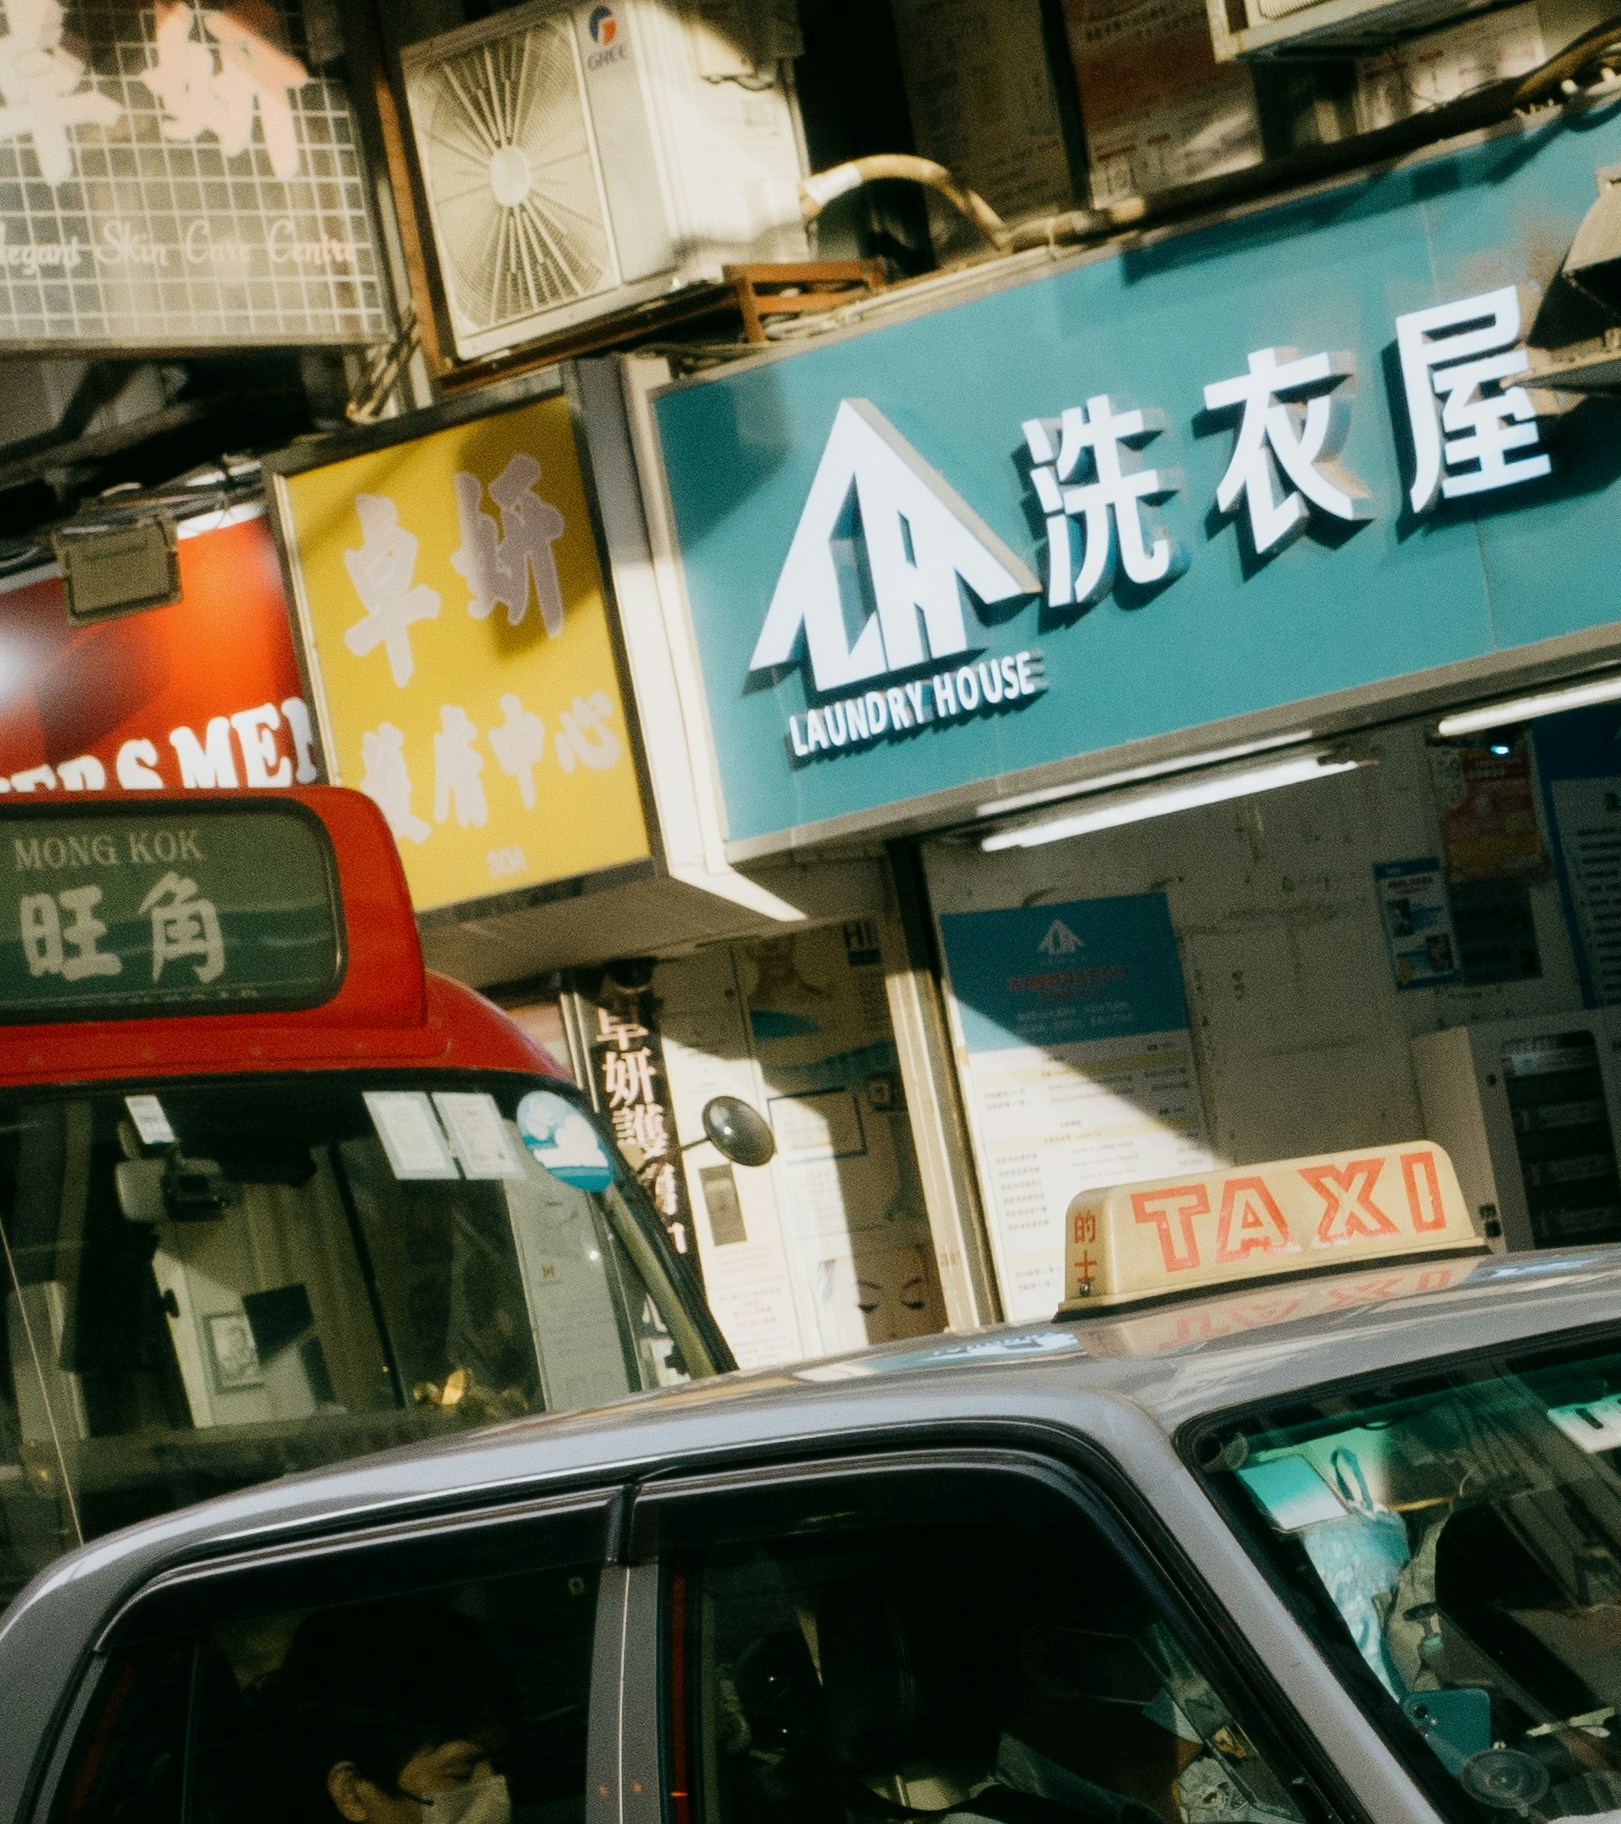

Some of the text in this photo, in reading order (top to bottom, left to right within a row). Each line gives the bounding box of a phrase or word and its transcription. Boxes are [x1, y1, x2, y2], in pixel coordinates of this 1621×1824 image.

[97, 218, 168, 266] Skin
[185, 219, 252, 265] Care
[266, 219, 358, 266] Centre
[1021, 284, 1553, 608] 洗衣屋
[789, 651, 1036, 757] LAUNDRY HOUSE
[14, 827, 205, 869] MONG KOK
[19, 872, 225, 985] 旺角
[1072, 1209, 1099, 1287] 的士
[1130, 1151, 1449, 1275] TAXI
